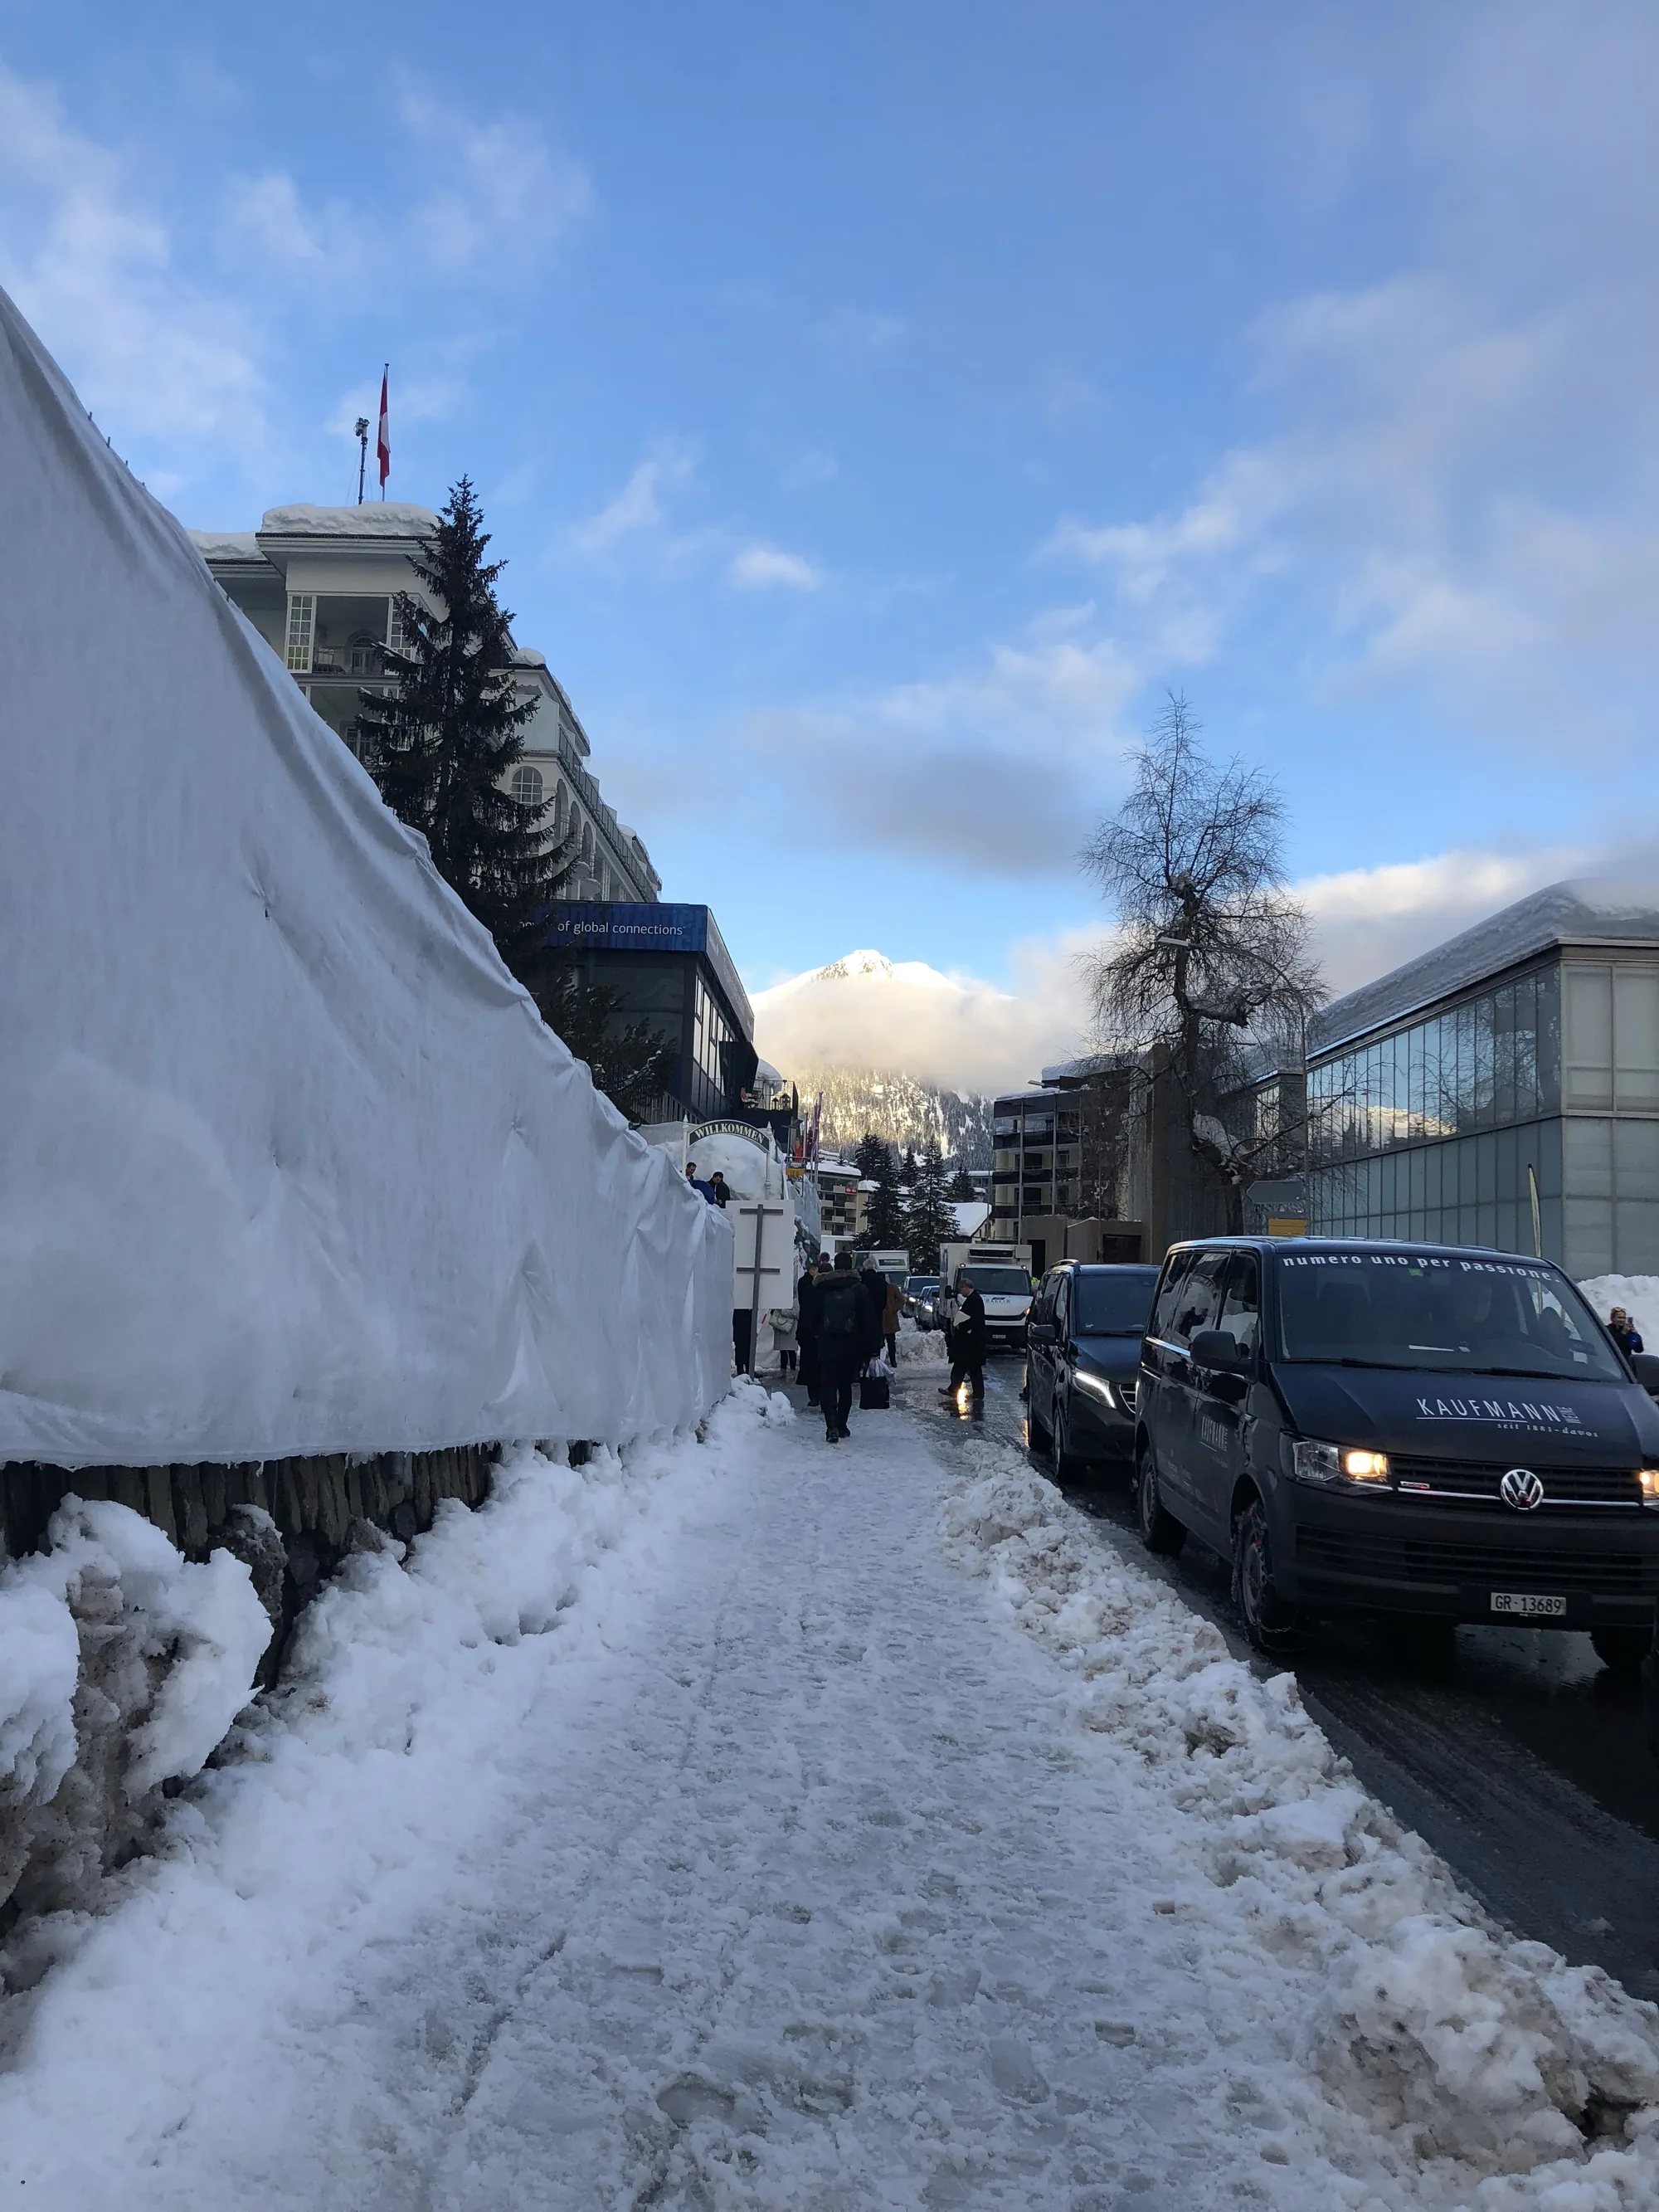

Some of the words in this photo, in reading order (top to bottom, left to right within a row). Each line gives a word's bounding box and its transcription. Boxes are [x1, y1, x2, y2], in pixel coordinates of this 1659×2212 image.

[557, 920, 571, 932] of
[573, 921, 609, 935] global
[612, 923, 684, 936] connections
[694, 1123, 765, 1144] WILLKOMMEN
[1282, 1255, 1362, 1267] numero
[1370, 1255, 1409, 1265] uno
[1416, 1258, 1451, 1269] per
[1416, 1398, 1561, 1422] KAUFMANN
[1497, 1422, 1520, 1430] seit
